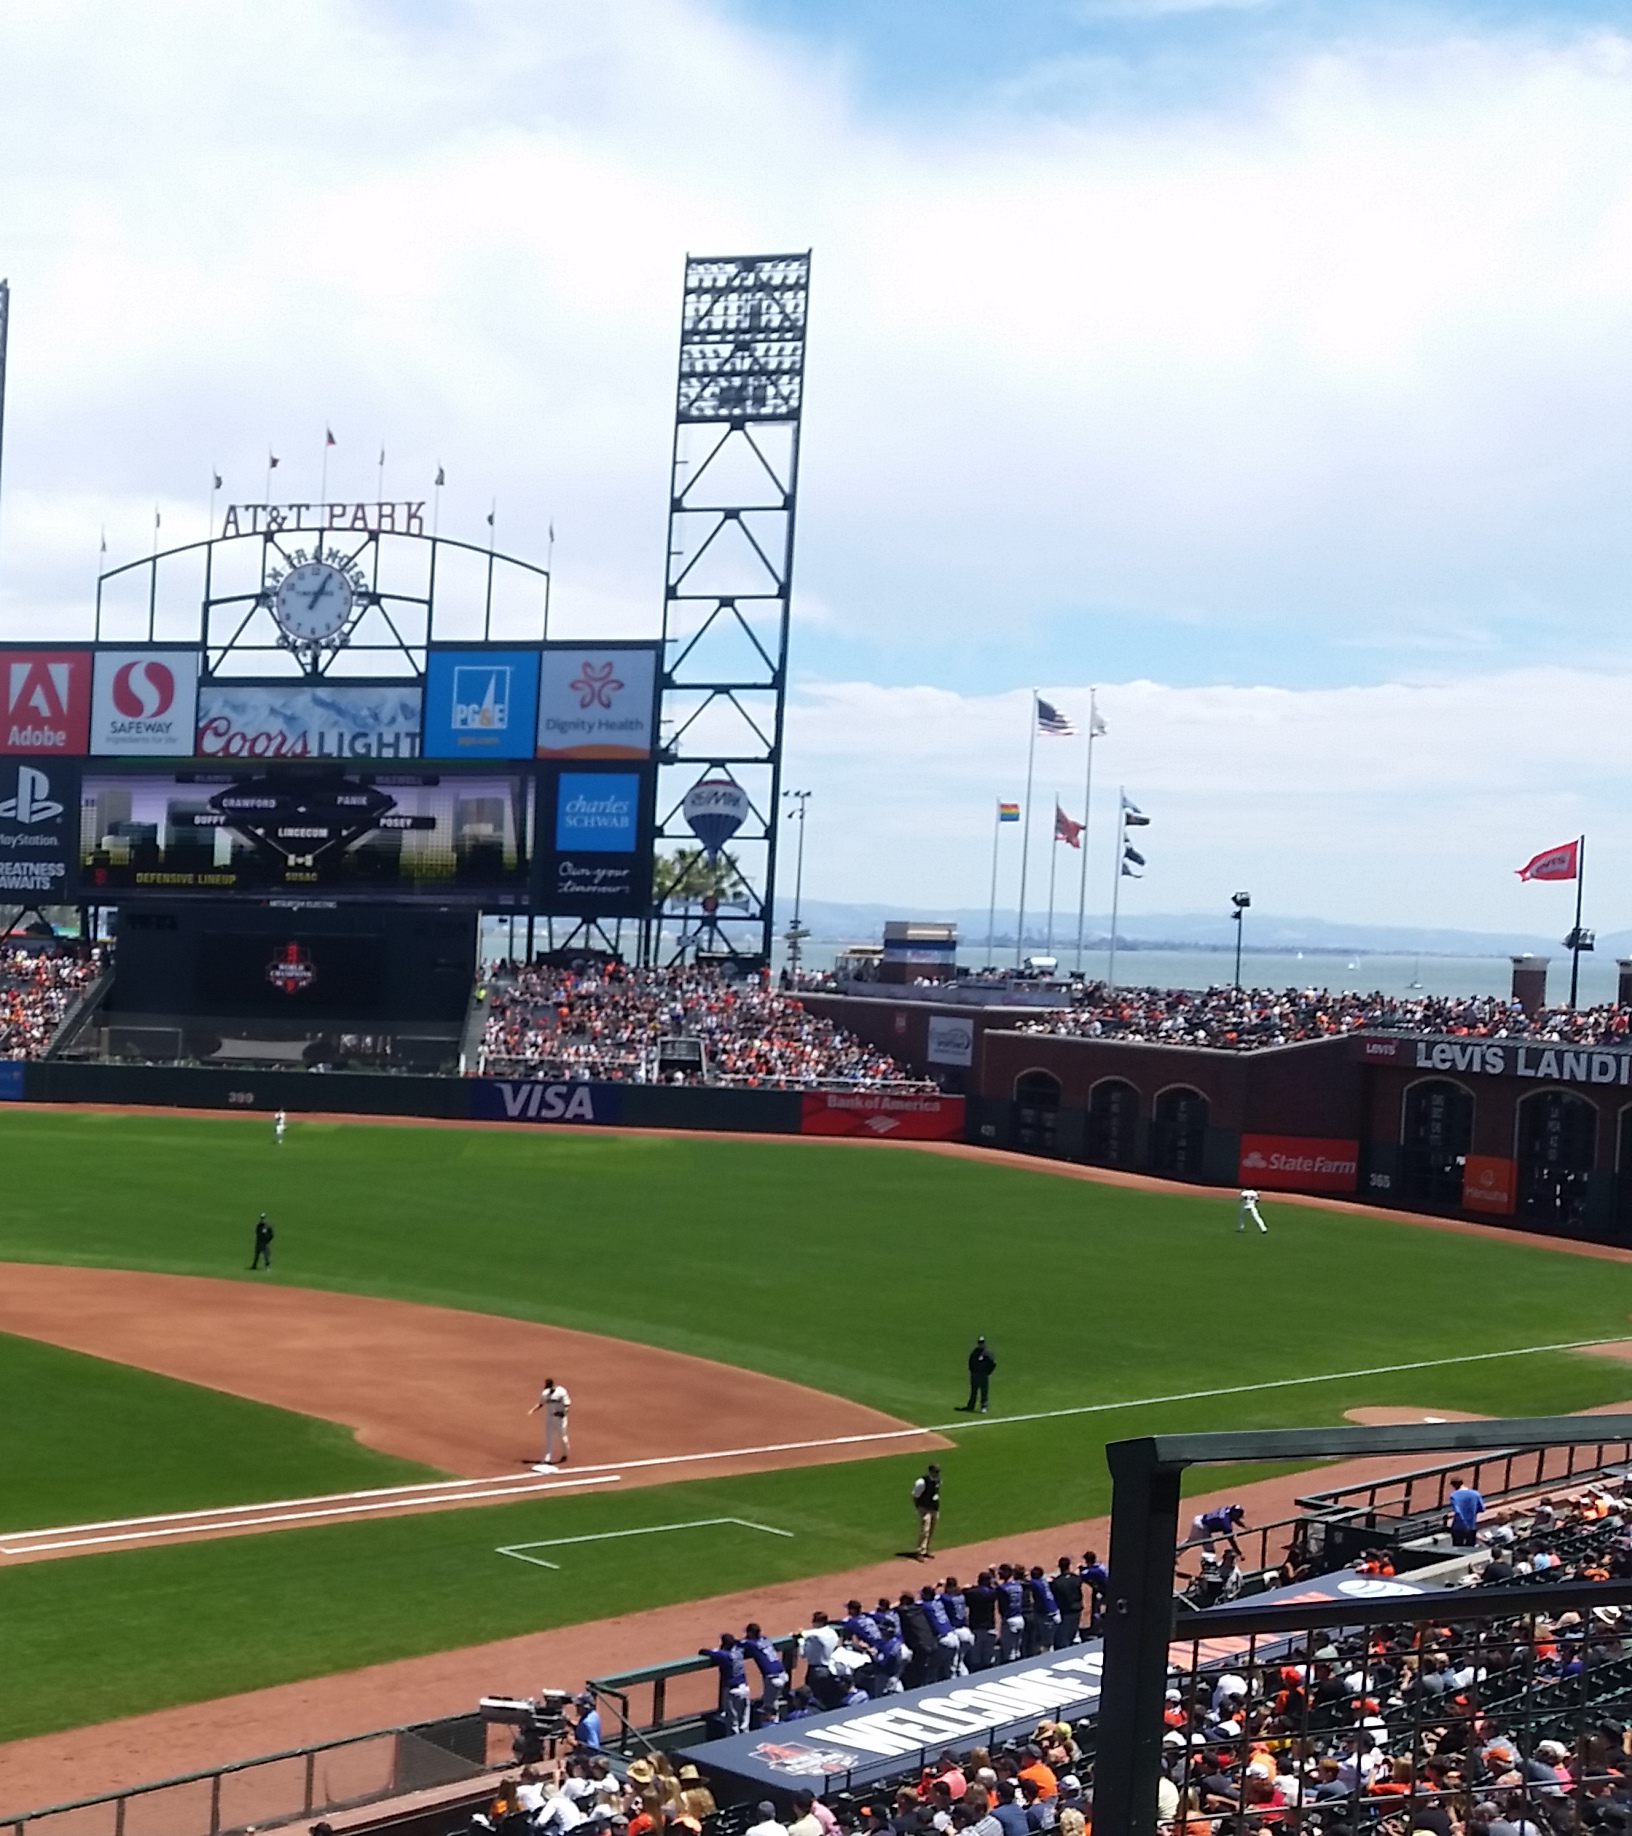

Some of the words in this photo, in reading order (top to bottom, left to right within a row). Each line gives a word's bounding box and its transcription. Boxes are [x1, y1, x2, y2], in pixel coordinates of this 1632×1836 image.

[222, 504, 310, 539] AT&T
[328, 501, 425, 535] PARK
[456, 703, 506, 727] PG&E
[110, 721, 172, 734] SAFEWAY
[546, 718, 594, 734] Dignity
[598, 718, 644, 732] Health
[8, 724, 66, 746] Adobe
[196, 716, 311, 757] Coors
[318, 731, 420, 758] LIGHT
[222, 798, 277, 809] CRAWFORD
[336, 796, 368, 806] PANIK
[566, 794, 629, 814] charles
[194, 814, 226, 825] DUFFY
[380, 818, 413, 828] POSEY
[565, 815, 630, 828] SCHWAB
[278, 827, 328, 838] LINCECUM
[136, 872, 194, 884] DEFENSIVE
[198, 874, 236, 884] LINEUP
[494, 1082, 594, 1120] VISA
[827, 1094, 863, 1108] Bank
[863, 1096, 878, 1110] of
[880, 1097, 940, 1112] America
[1370, 1174, 1390, 1188] 365
[804, 1667, 1093, 1756] WELCOME
